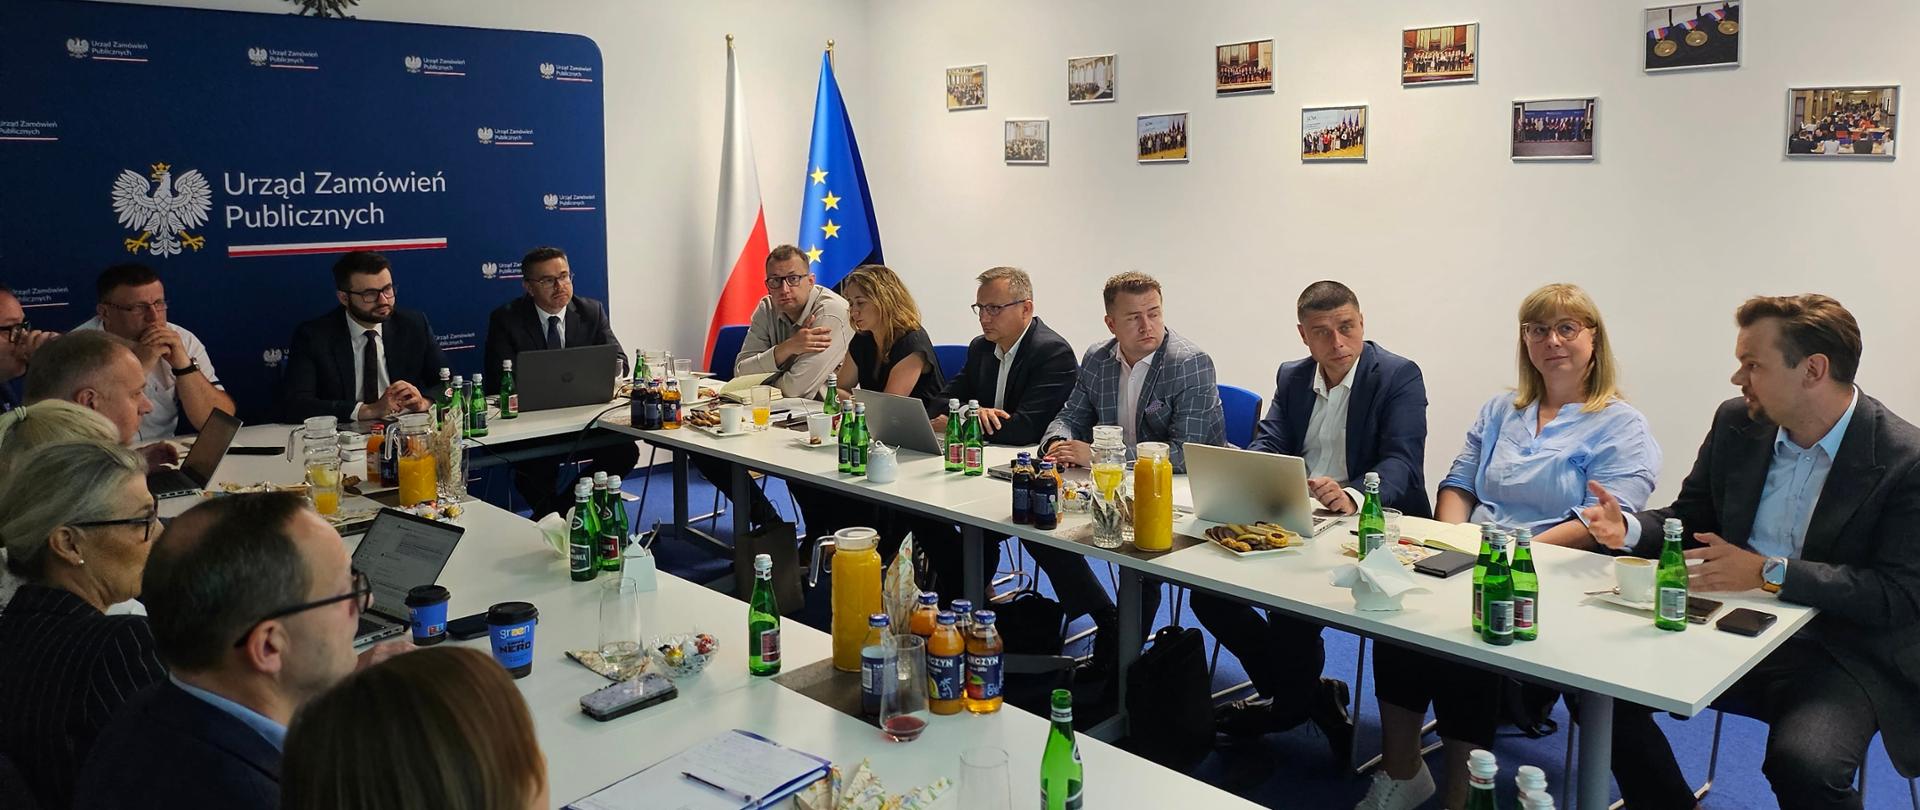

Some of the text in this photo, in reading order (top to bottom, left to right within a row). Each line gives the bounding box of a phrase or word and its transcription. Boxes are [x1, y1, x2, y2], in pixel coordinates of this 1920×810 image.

[224, 171, 446, 199] Urząd Zamówień
[226, 202, 384, 229] Publicznych
[928, 656, 953, 667] CZYN
[967, 655, 999, 666] ARCZYN
